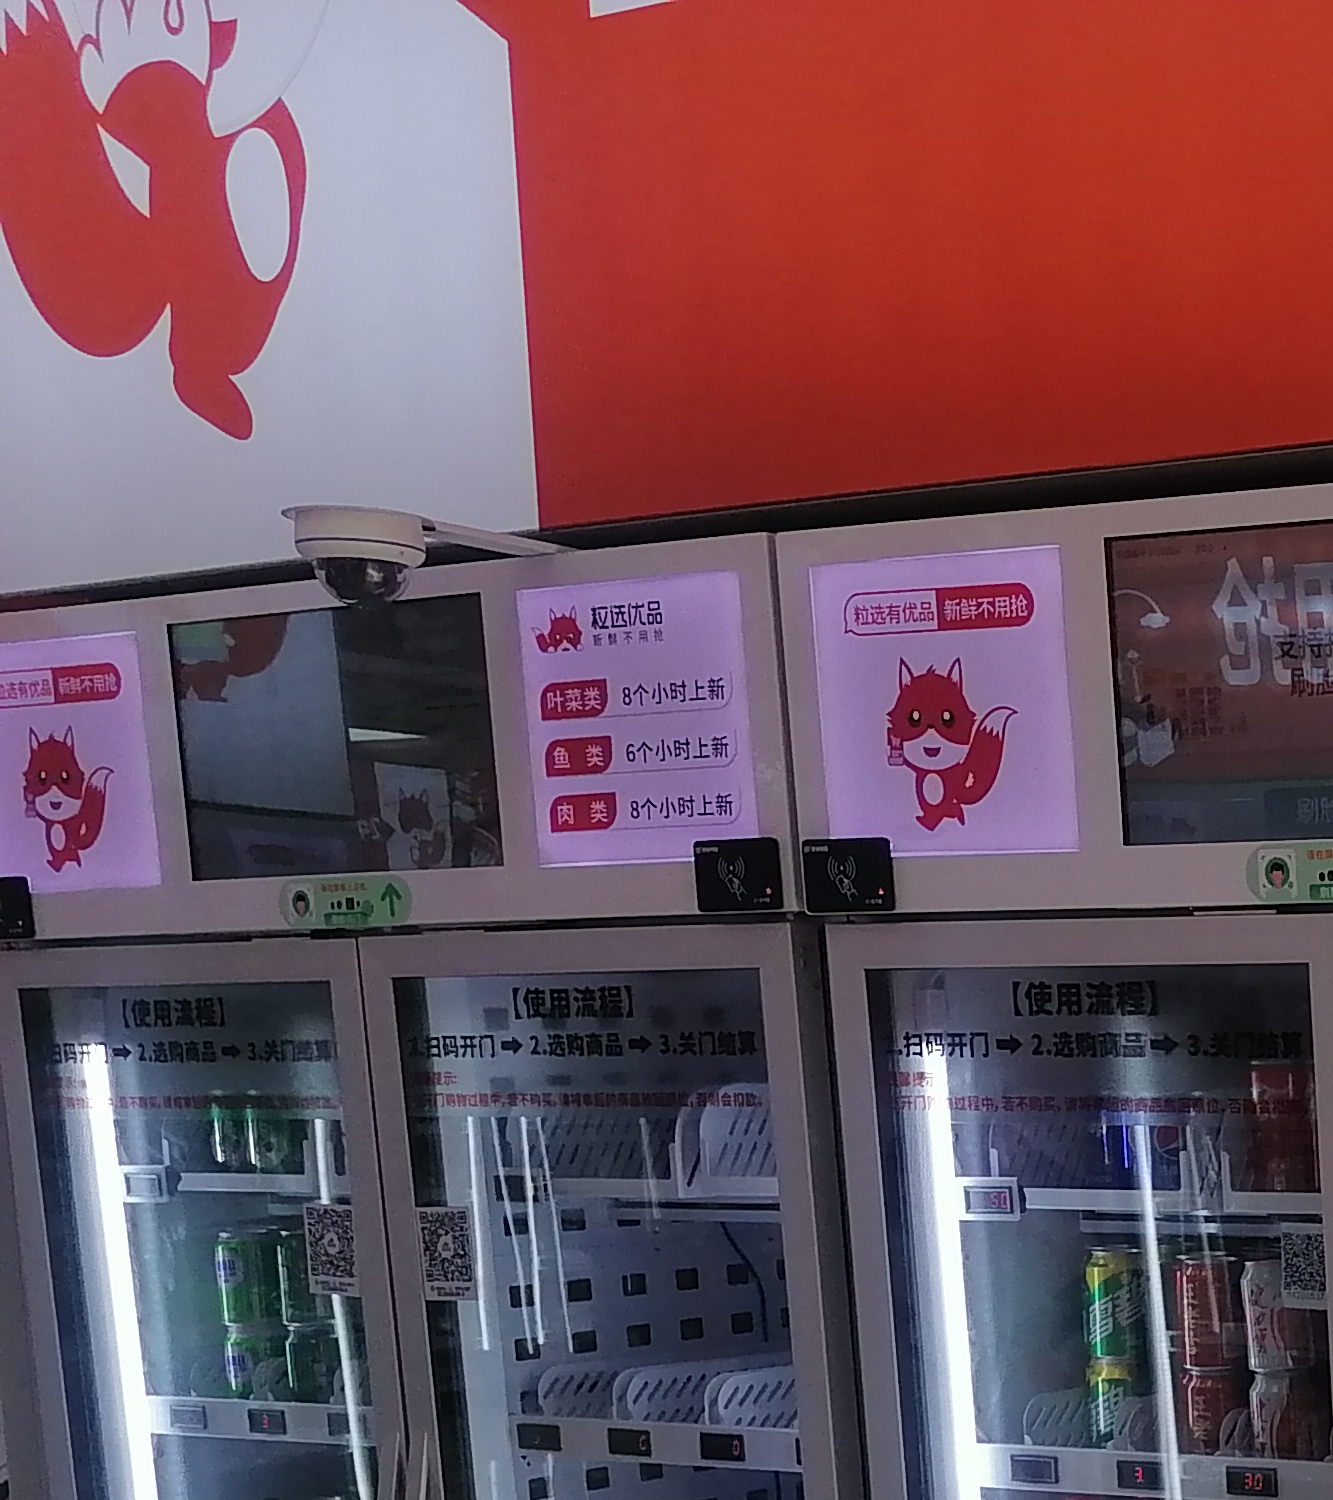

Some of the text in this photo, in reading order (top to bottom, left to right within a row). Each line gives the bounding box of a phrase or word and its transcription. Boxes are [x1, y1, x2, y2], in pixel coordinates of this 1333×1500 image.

[591, 600, 663, 630] 粒选优品
[854, 594, 1028, 626] 粒选有优品 新鲜不用抢
[546, 677, 725, 713] 叶菜类 8个小时上新
[626, 736, 729, 763] 6个小时上新
[630, 793, 733, 820] 8个小时上新
